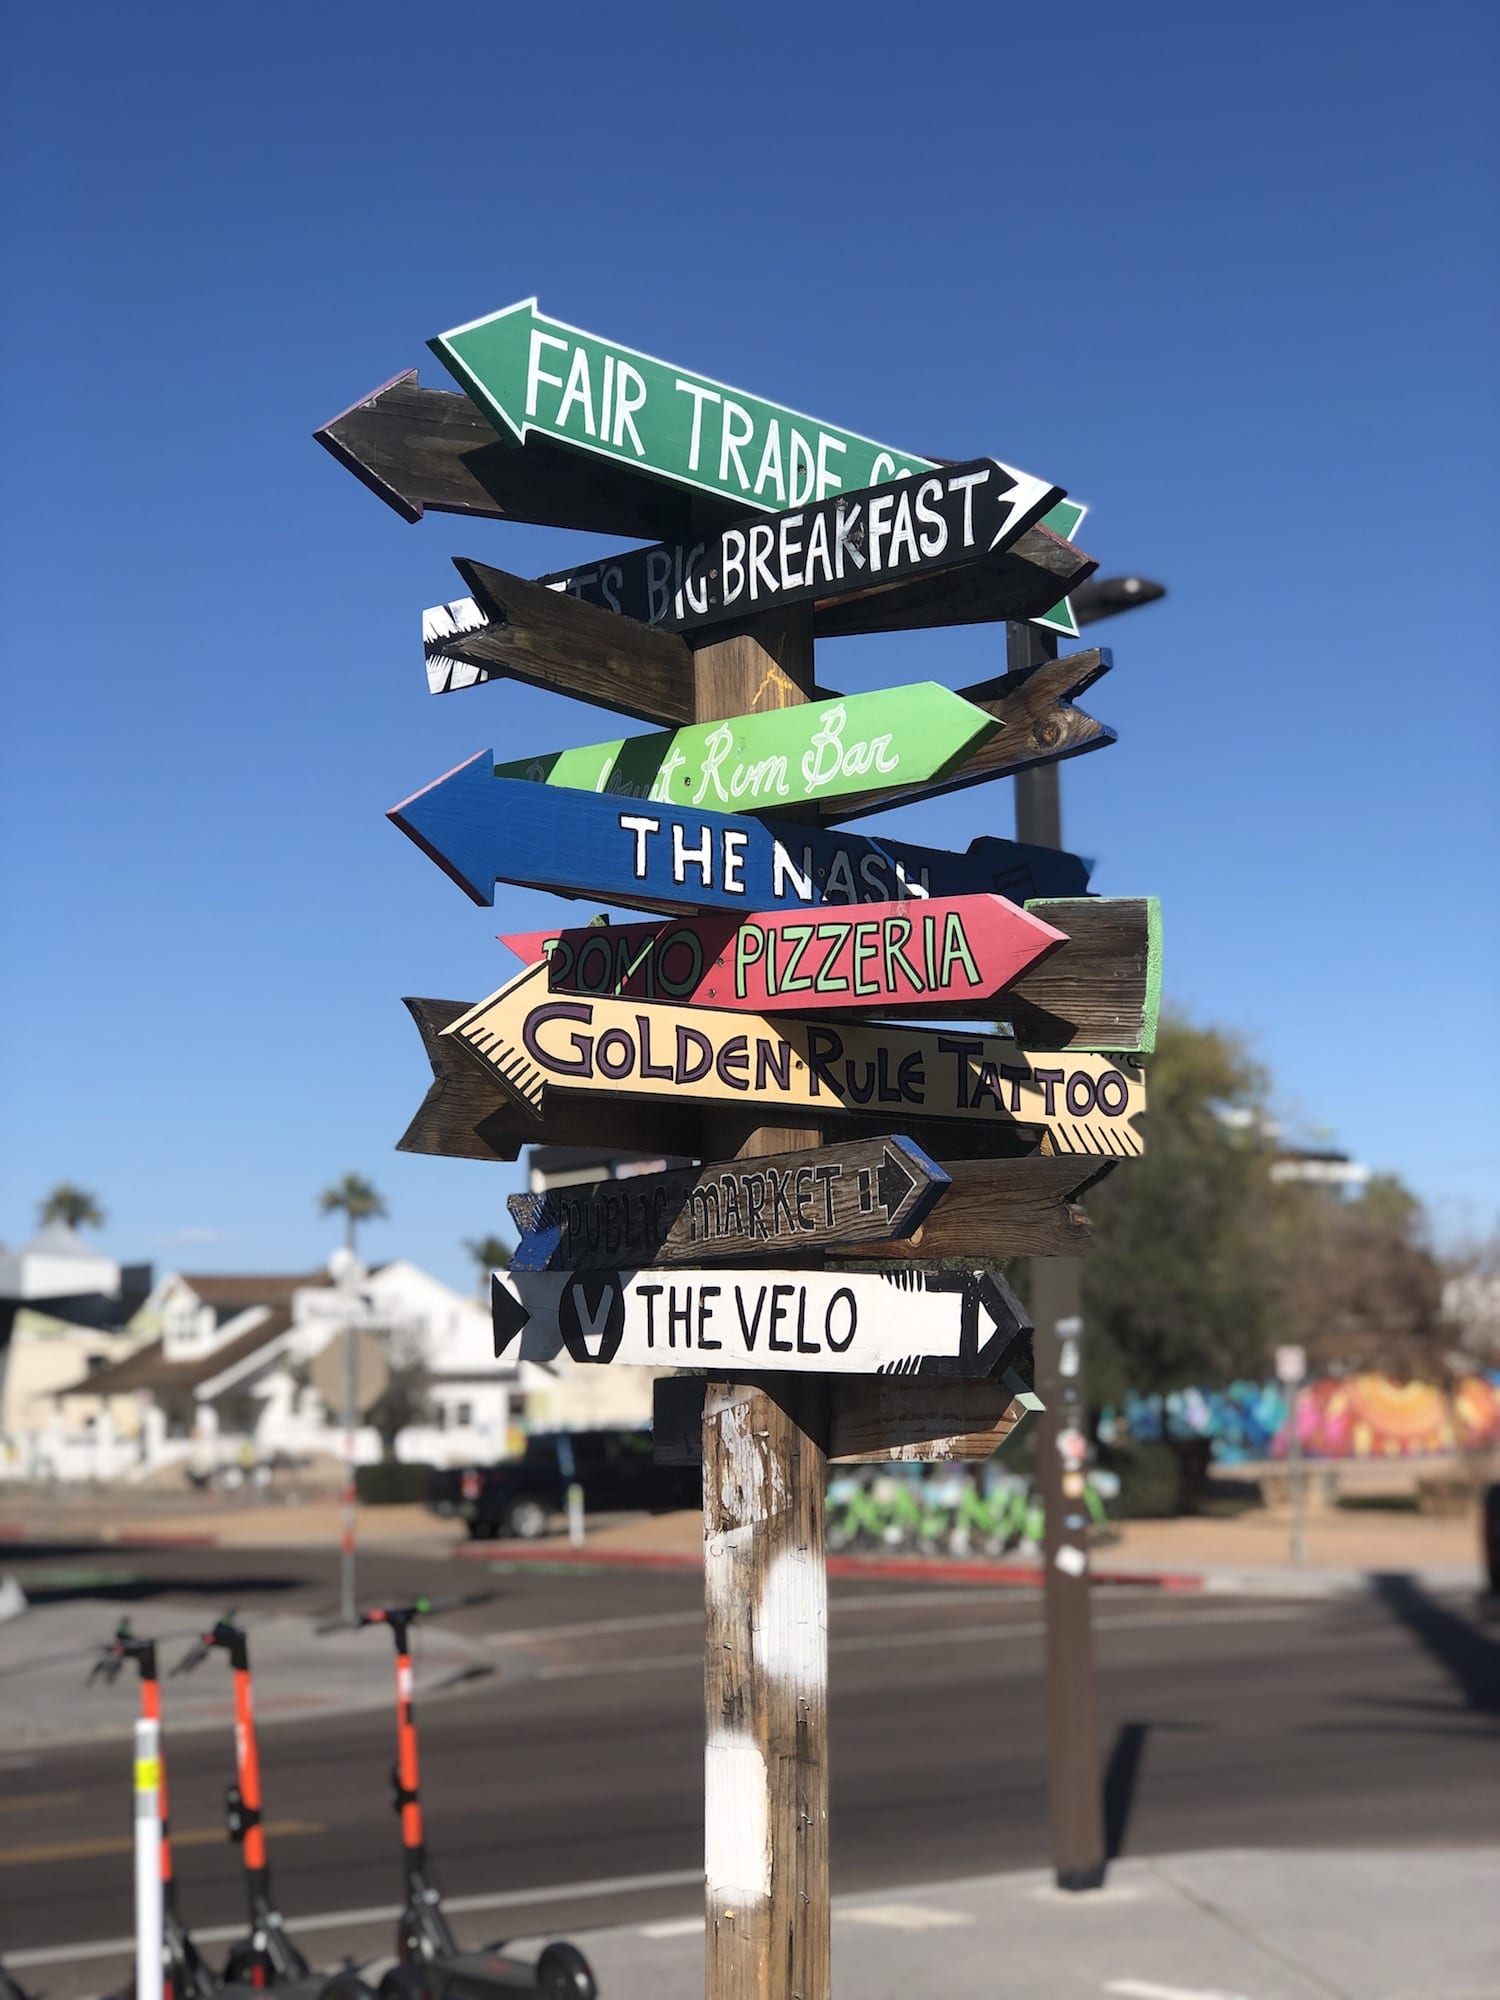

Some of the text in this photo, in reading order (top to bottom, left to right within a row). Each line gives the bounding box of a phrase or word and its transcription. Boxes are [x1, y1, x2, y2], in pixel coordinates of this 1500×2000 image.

[526, 329, 847, 508] FAIR TRADE
[646, 545, 709, 624] BIG
[722, 469, 990, 606] BREAKFAST
[692, 722, 789, 804] Rum
[801, 703, 899, 793] Bar
[618, 814, 931, 904] THE NASH
[543, 912, 983, 998] POMO PIZZERIA
[523, 1001, 1129, 1117] GOLDEN RULE TATTOO
[561, 1164, 843, 1260] PUBLIC MARKET
[636, 1285, 723, 1350] THE
[735, 1285, 857, 1353] VELO
